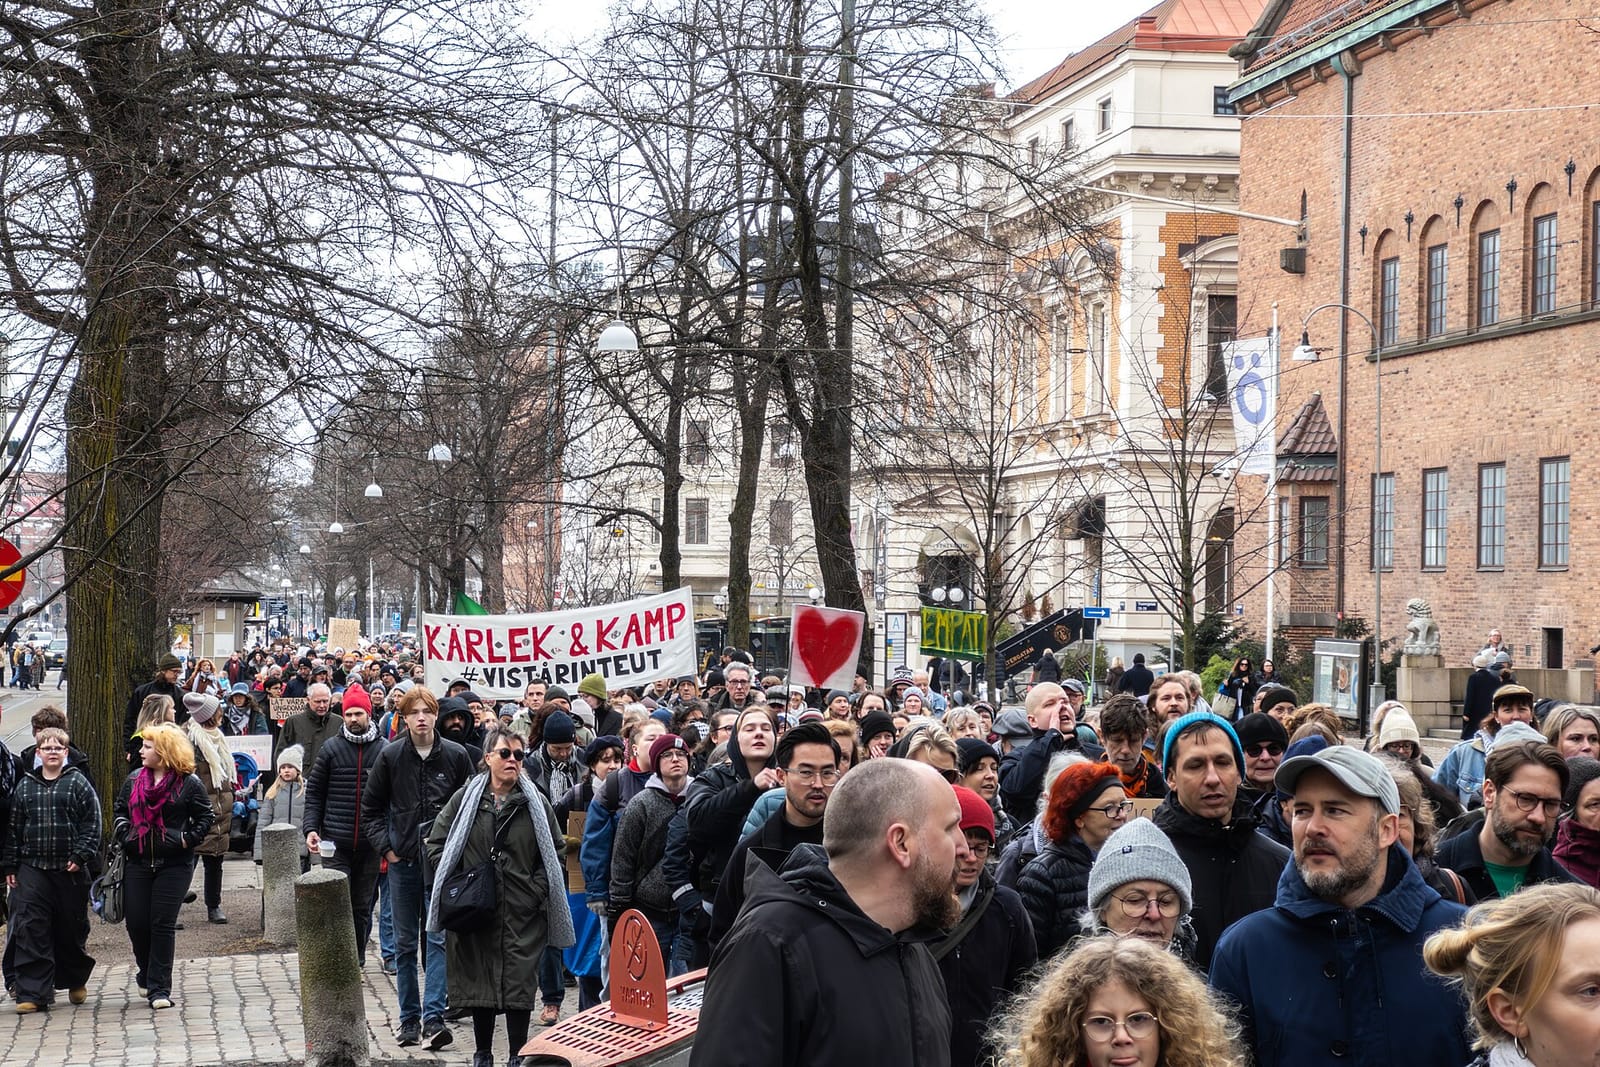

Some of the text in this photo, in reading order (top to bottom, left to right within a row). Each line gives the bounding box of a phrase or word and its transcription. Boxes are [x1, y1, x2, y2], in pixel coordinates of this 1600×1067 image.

[1234, 353, 1267, 425] Ö
[424, 602, 686, 663] KÄRLEK & KAMP
[921, 607, 987, 656] EMPATI
[460, 649, 662, 688] #VISTÅRINTEUT
